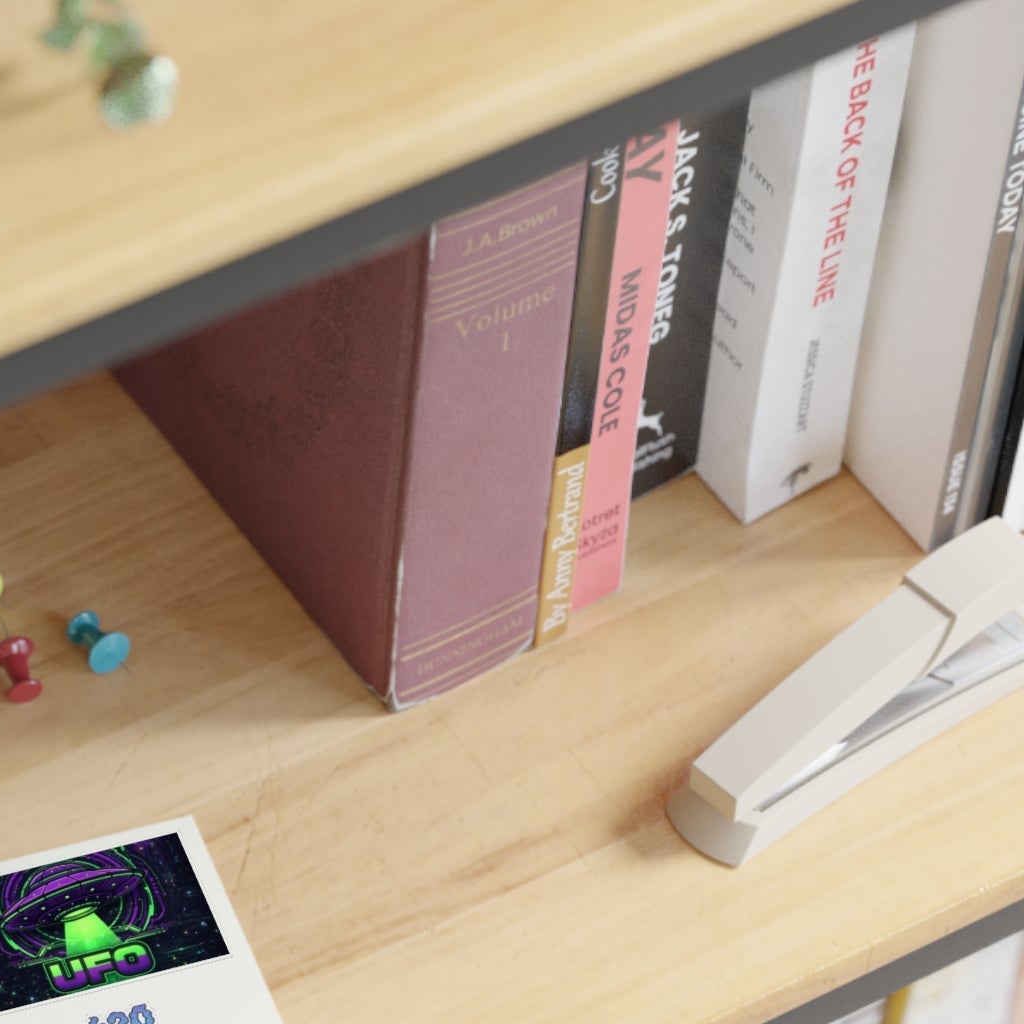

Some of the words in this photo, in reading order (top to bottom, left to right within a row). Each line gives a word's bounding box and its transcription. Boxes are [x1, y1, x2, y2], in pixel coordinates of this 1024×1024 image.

[839, 78, 873, 154] BACK
[669, 129, 701, 211] JACK
[834, 156, 859, 192] OF
[824, 194, 852, 250] THE
[812, 249, 843, 308] LINE
[455, 286, 556, 338] Volume
[609, 267, 643, 363] MIDAS
[598, 367, 626, 437] COLE
[946, 449, 968, 493] ISSUE
[551, 460, 585, 550] Bertrand
[542, 602, 570, 633] By
[49, 941, 153, 991] UFO
